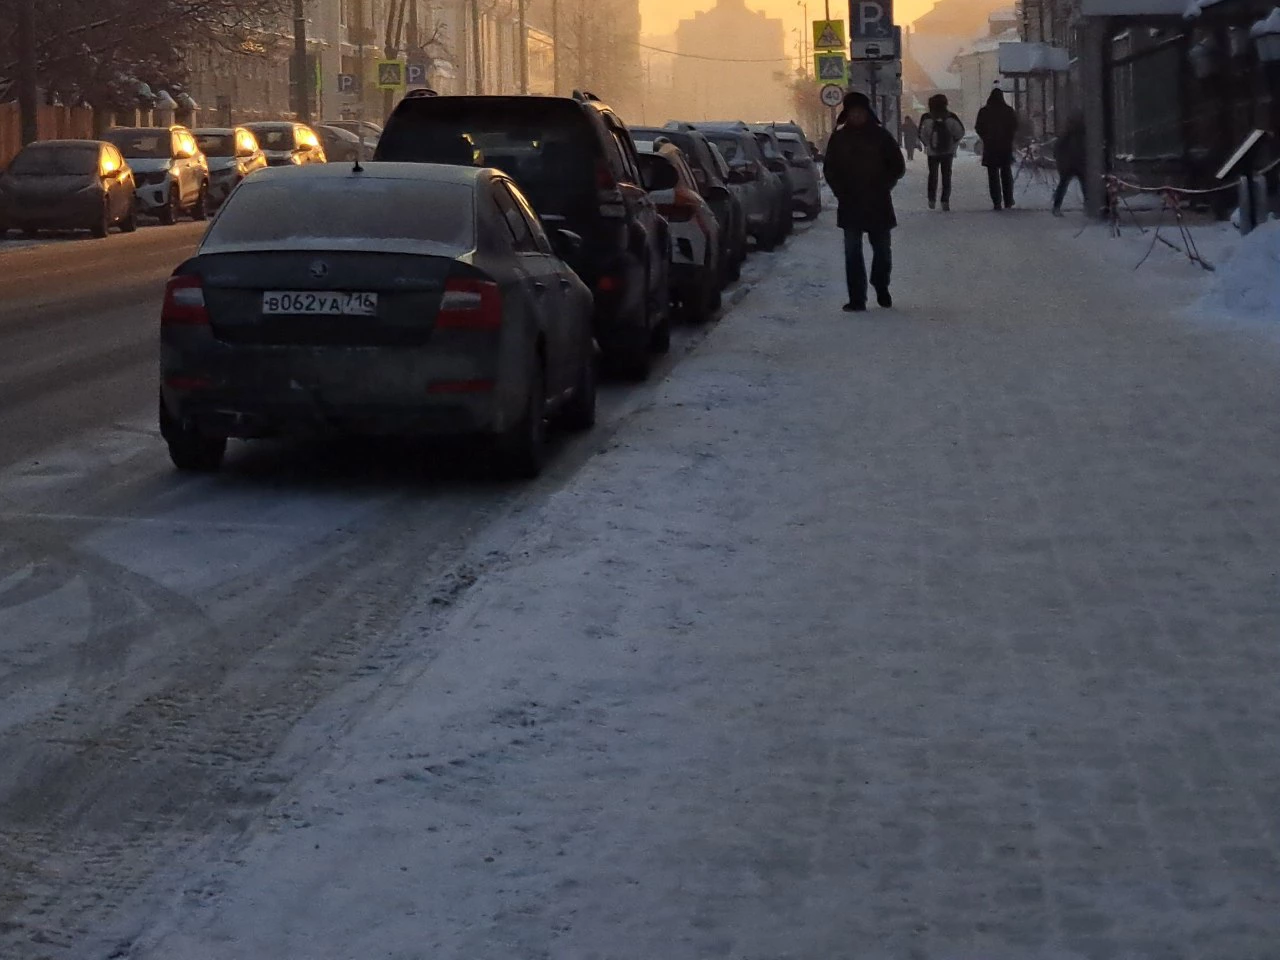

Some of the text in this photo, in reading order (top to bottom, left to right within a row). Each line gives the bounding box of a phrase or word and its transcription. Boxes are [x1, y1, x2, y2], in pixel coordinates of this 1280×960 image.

[859, 1, 884, 35] P
[409, 66, 421, 82] P
[342, 76, 352, 91] P
[825, 90, 840, 102] 40
